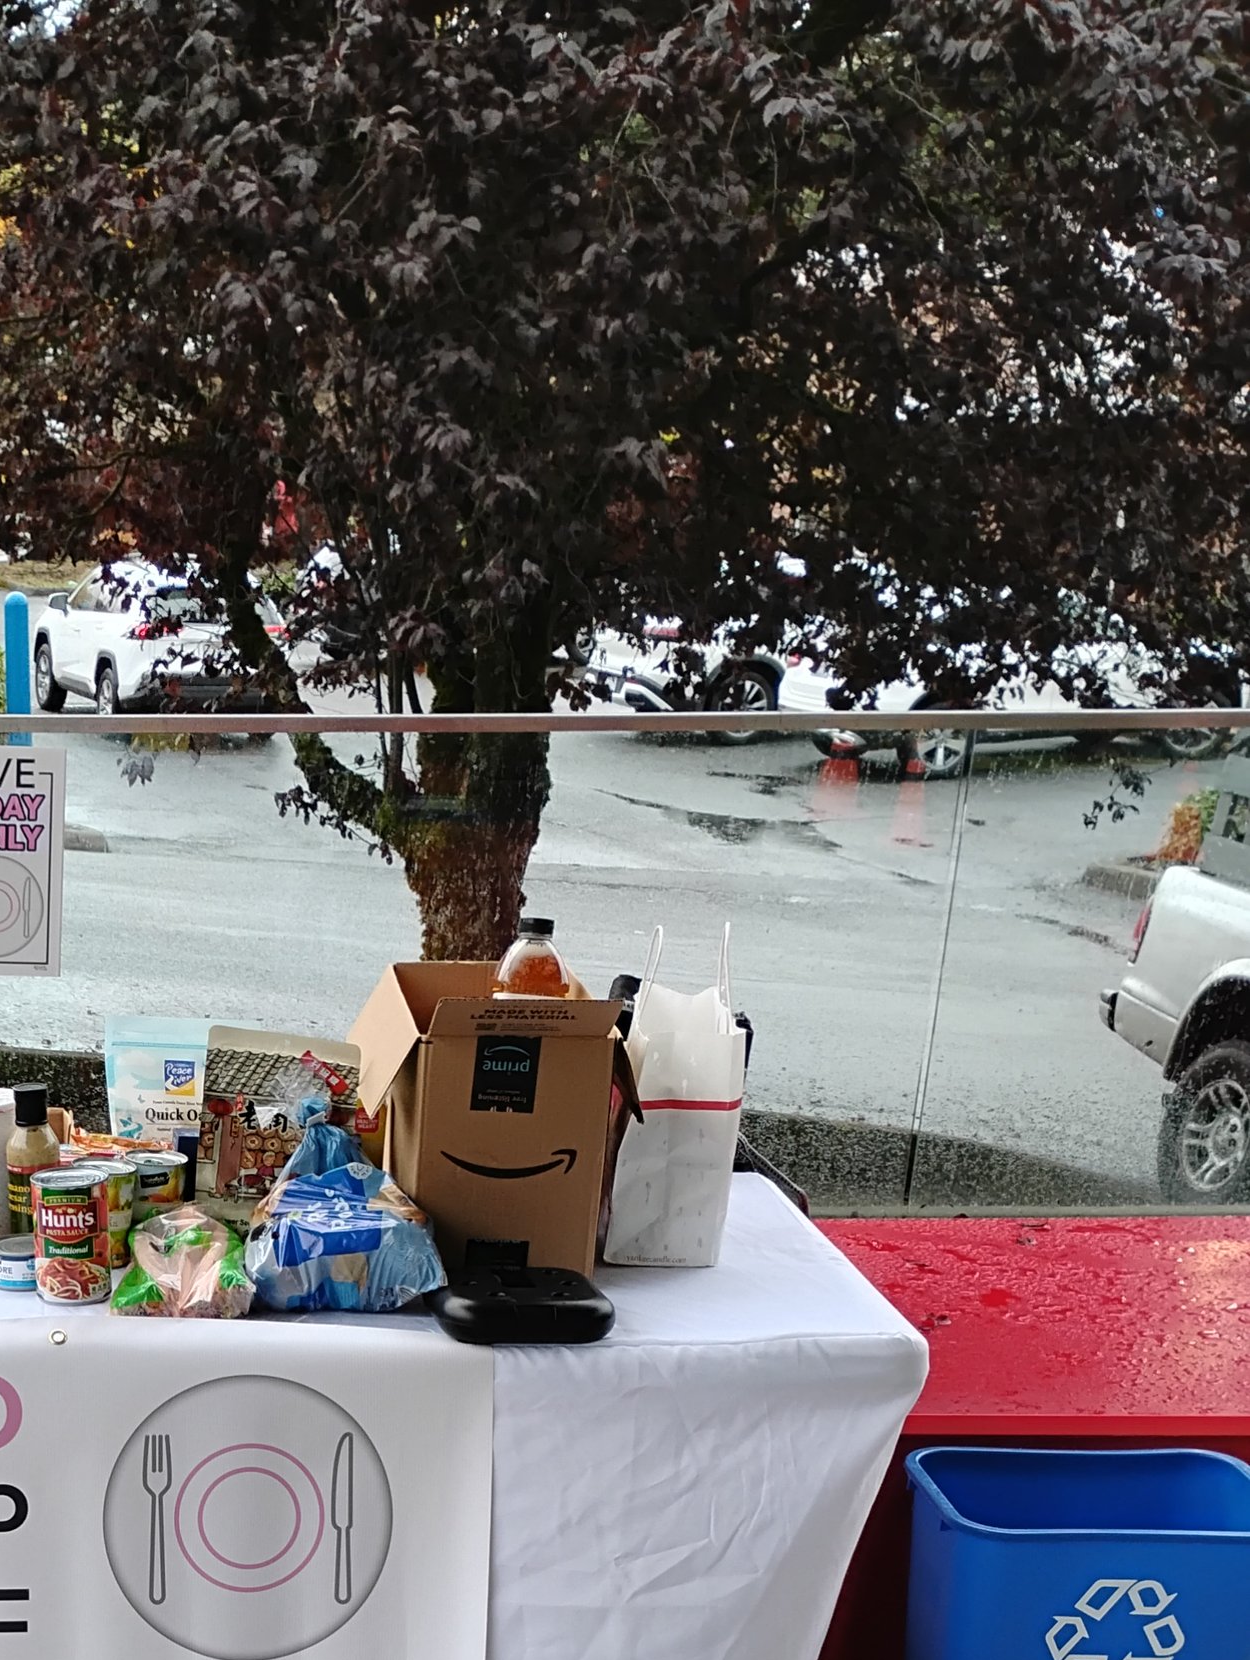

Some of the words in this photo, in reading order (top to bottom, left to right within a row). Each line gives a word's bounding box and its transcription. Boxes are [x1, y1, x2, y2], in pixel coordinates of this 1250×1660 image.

[165, 1063, 192, 1075] Peace
[482, 1059, 530, 1073] prime
[145, 1107, 184, 1122] Quick
[8, 1184, 31, 1192] mano
[41, 1208, 94, 1228] Hunt's
[67, 1228, 89, 1236] SAUCE
[48, 1245, 89, 1254] Traditional
